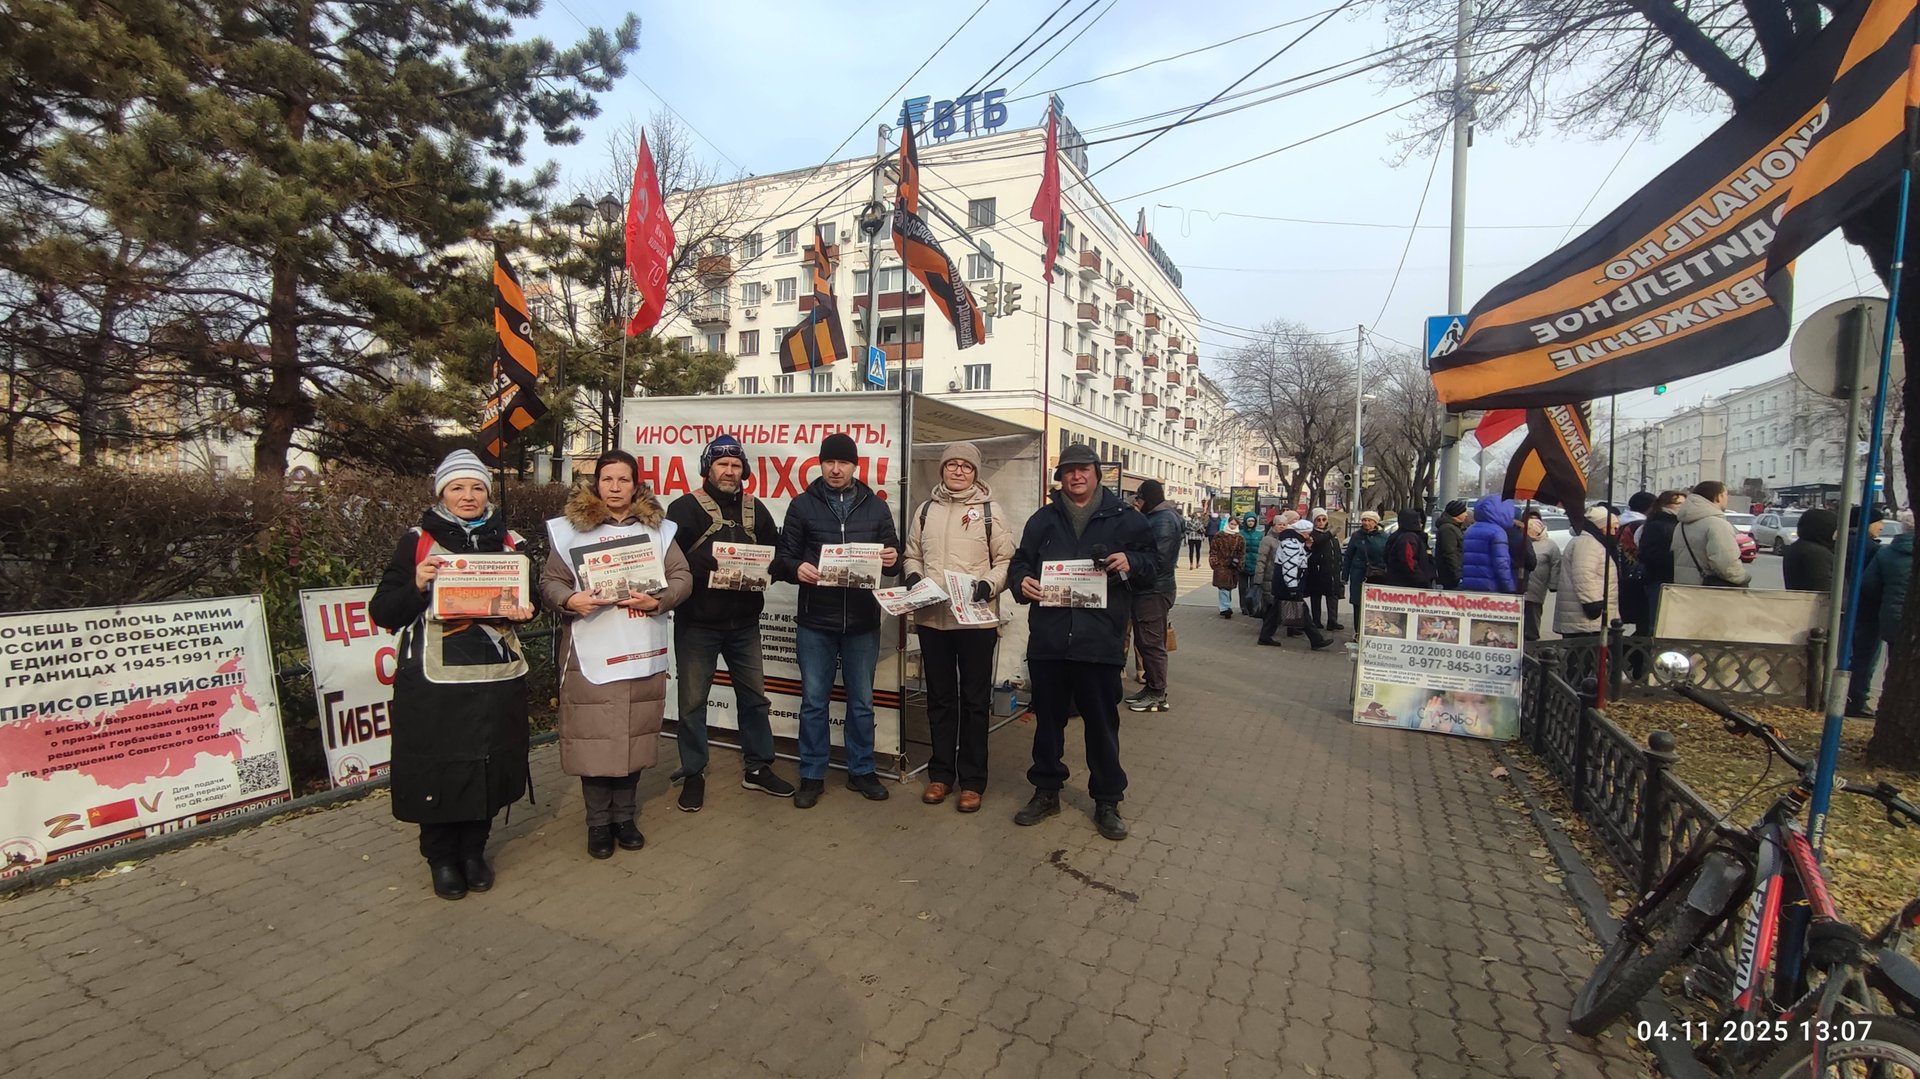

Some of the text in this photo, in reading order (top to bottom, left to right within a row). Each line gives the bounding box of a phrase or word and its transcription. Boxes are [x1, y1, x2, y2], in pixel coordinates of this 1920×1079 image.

[932, 88, 1007, 139] ВТБ
[636, 423, 892, 448] ИНОСТРАННЫЕ АГЕНТЫ,
[637, 456, 690, 496] НА
[0, 607, 232, 640] ОЧЕШЬ ПОМОЧЬ АРМИИ
[71, 637, 83, 648] В
[90, 619, 244, 646] ОСВОБОЖДЕНИИ
[760, 624, 786, 632] ательные
[10, 635, 223, 672] ЕДИНОГО ОТЕЧЕСТВА
[762, 644, 779, 652] ствия
[1365, 640, 1512, 663] Карта 2202 2003 0640 6669
[5, 663, 116, 688] ГРАНИЦАХ
[123, 651, 211, 672] 1945-1991
[1408, 657, 1512, 676] 8-977-845-31-32
[0, 672, 243, 721] ПРИСОЕДИНЯЙСЯ!!!
[56, 720, 91, 735] ИСКУ
[105, 707, 173, 726] Верховный
[176, 702, 199, 714] СУД
[201, 700, 217, 709] РФ
[768, 708, 800, 719] ЕФЕРЕ
[62, 727, 132, 747] признании
[135, 713, 215, 732] незаконными
[22, 770, 38, 779] по
[42, 752, 125, 777] разрушению
[129, 738, 193, 757] Советского
[48, 744, 105, 762] решений
[172, 776, 225, 796] Для подачи
[174, 783, 232, 802] иска перейди
[175, 801, 187, 810] по
